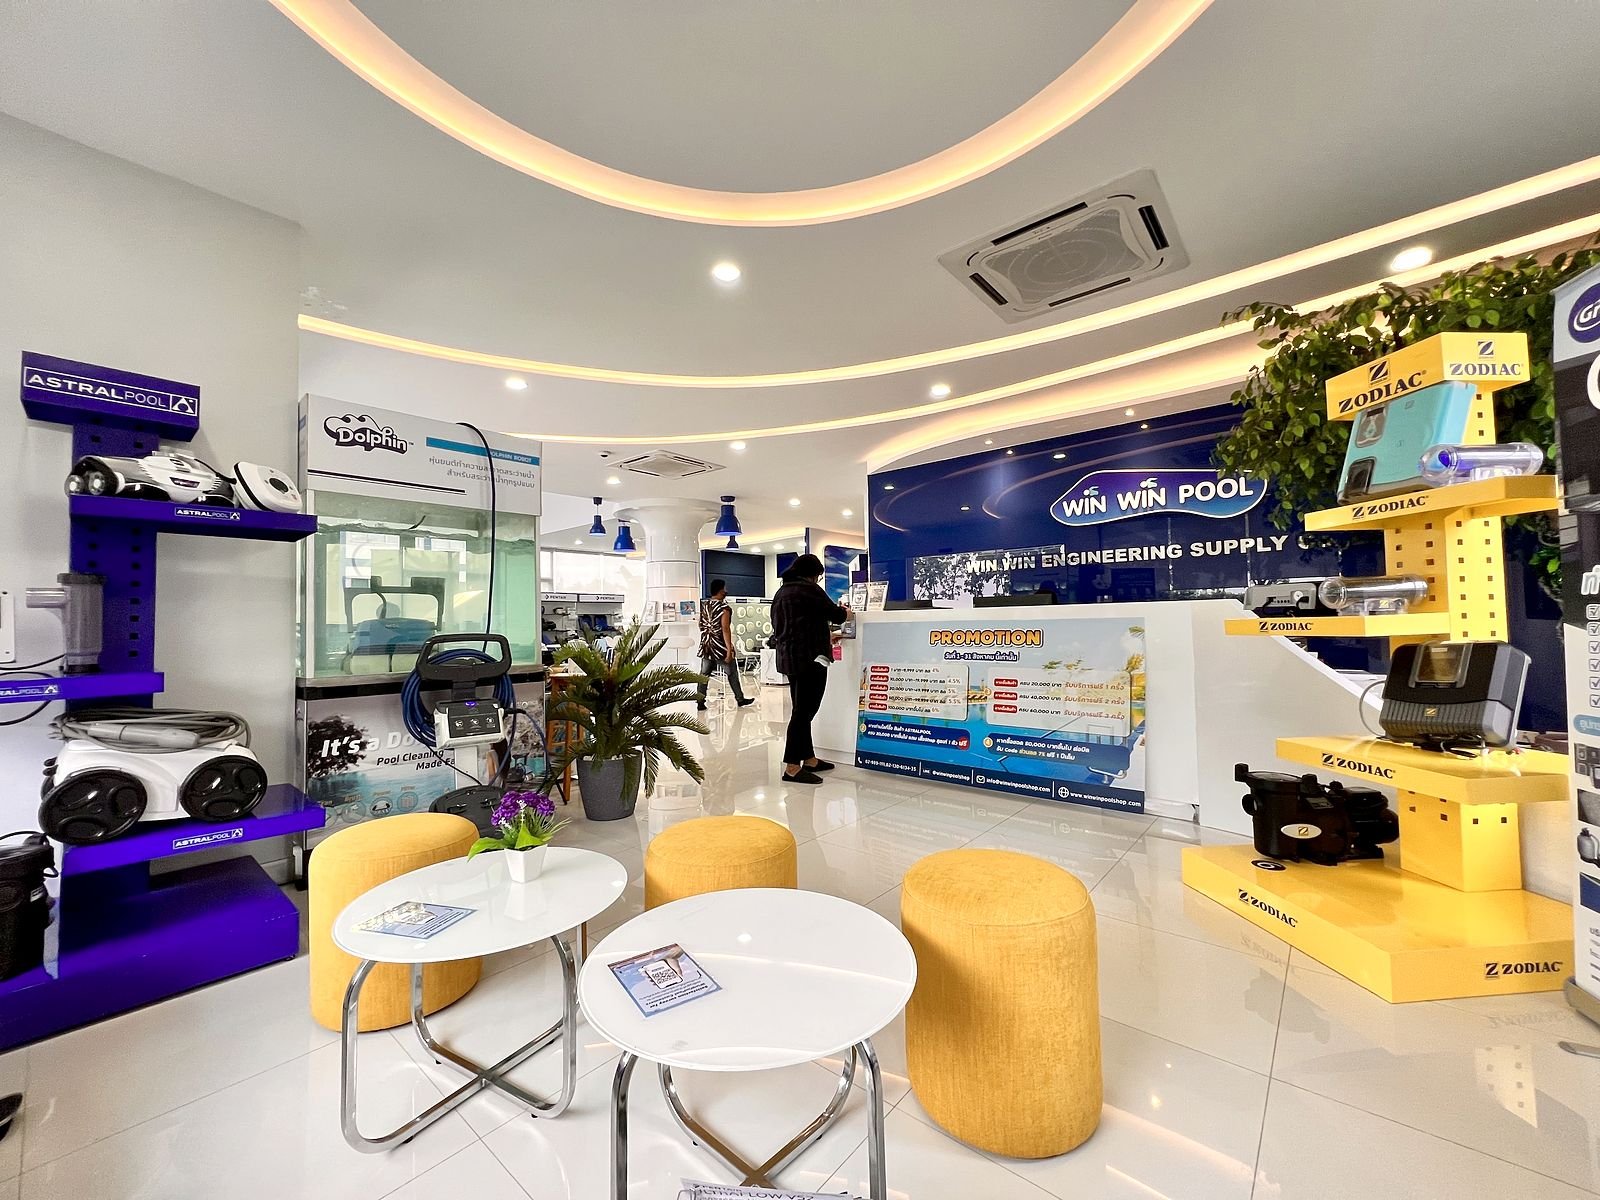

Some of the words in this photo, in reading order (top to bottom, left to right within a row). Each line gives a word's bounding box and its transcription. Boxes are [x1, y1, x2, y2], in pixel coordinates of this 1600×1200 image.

[1450, 363, 1521, 376] ZODIAC
[28, 373, 167, 408] ASTRALPOOL
[1339, 372, 1423, 413] ZODIAC
[336, 426, 408, 452] Dolphin
[447, 468, 535, 488] สำหรับสระว่าน้ำทุกรูปแบบ
[1062, 494, 1107, 518] WIN
[1117, 486, 1167, 511] WIN
[1178, 476, 1254, 504] POOL
[1367, 496, 1426, 515] ZODIAC
[176, 508, 229, 519] ASTRALPOOL
[966, 558, 998, 574] WIN
[1002, 555, 1037, 571] WIN
[1042, 544, 1184, 567] ENGINEERING
[1190, 535, 1289, 557] SUPPLY
[1270, 622, 1312, 631] ZODIAC
[929, 629, 1042, 646] PROMOTION
[368, 736, 380, 750] a
[376, 754, 400, 766] Pool
[416, 760, 442, 770] Made
[1336, 758, 1394, 780] ZODIAC
[174, 832, 230, 848] ASTRALPOOL
[1250, 896, 1296, 928] ZODIAC
[1502, 962, 1560, 975] ZODIAC
